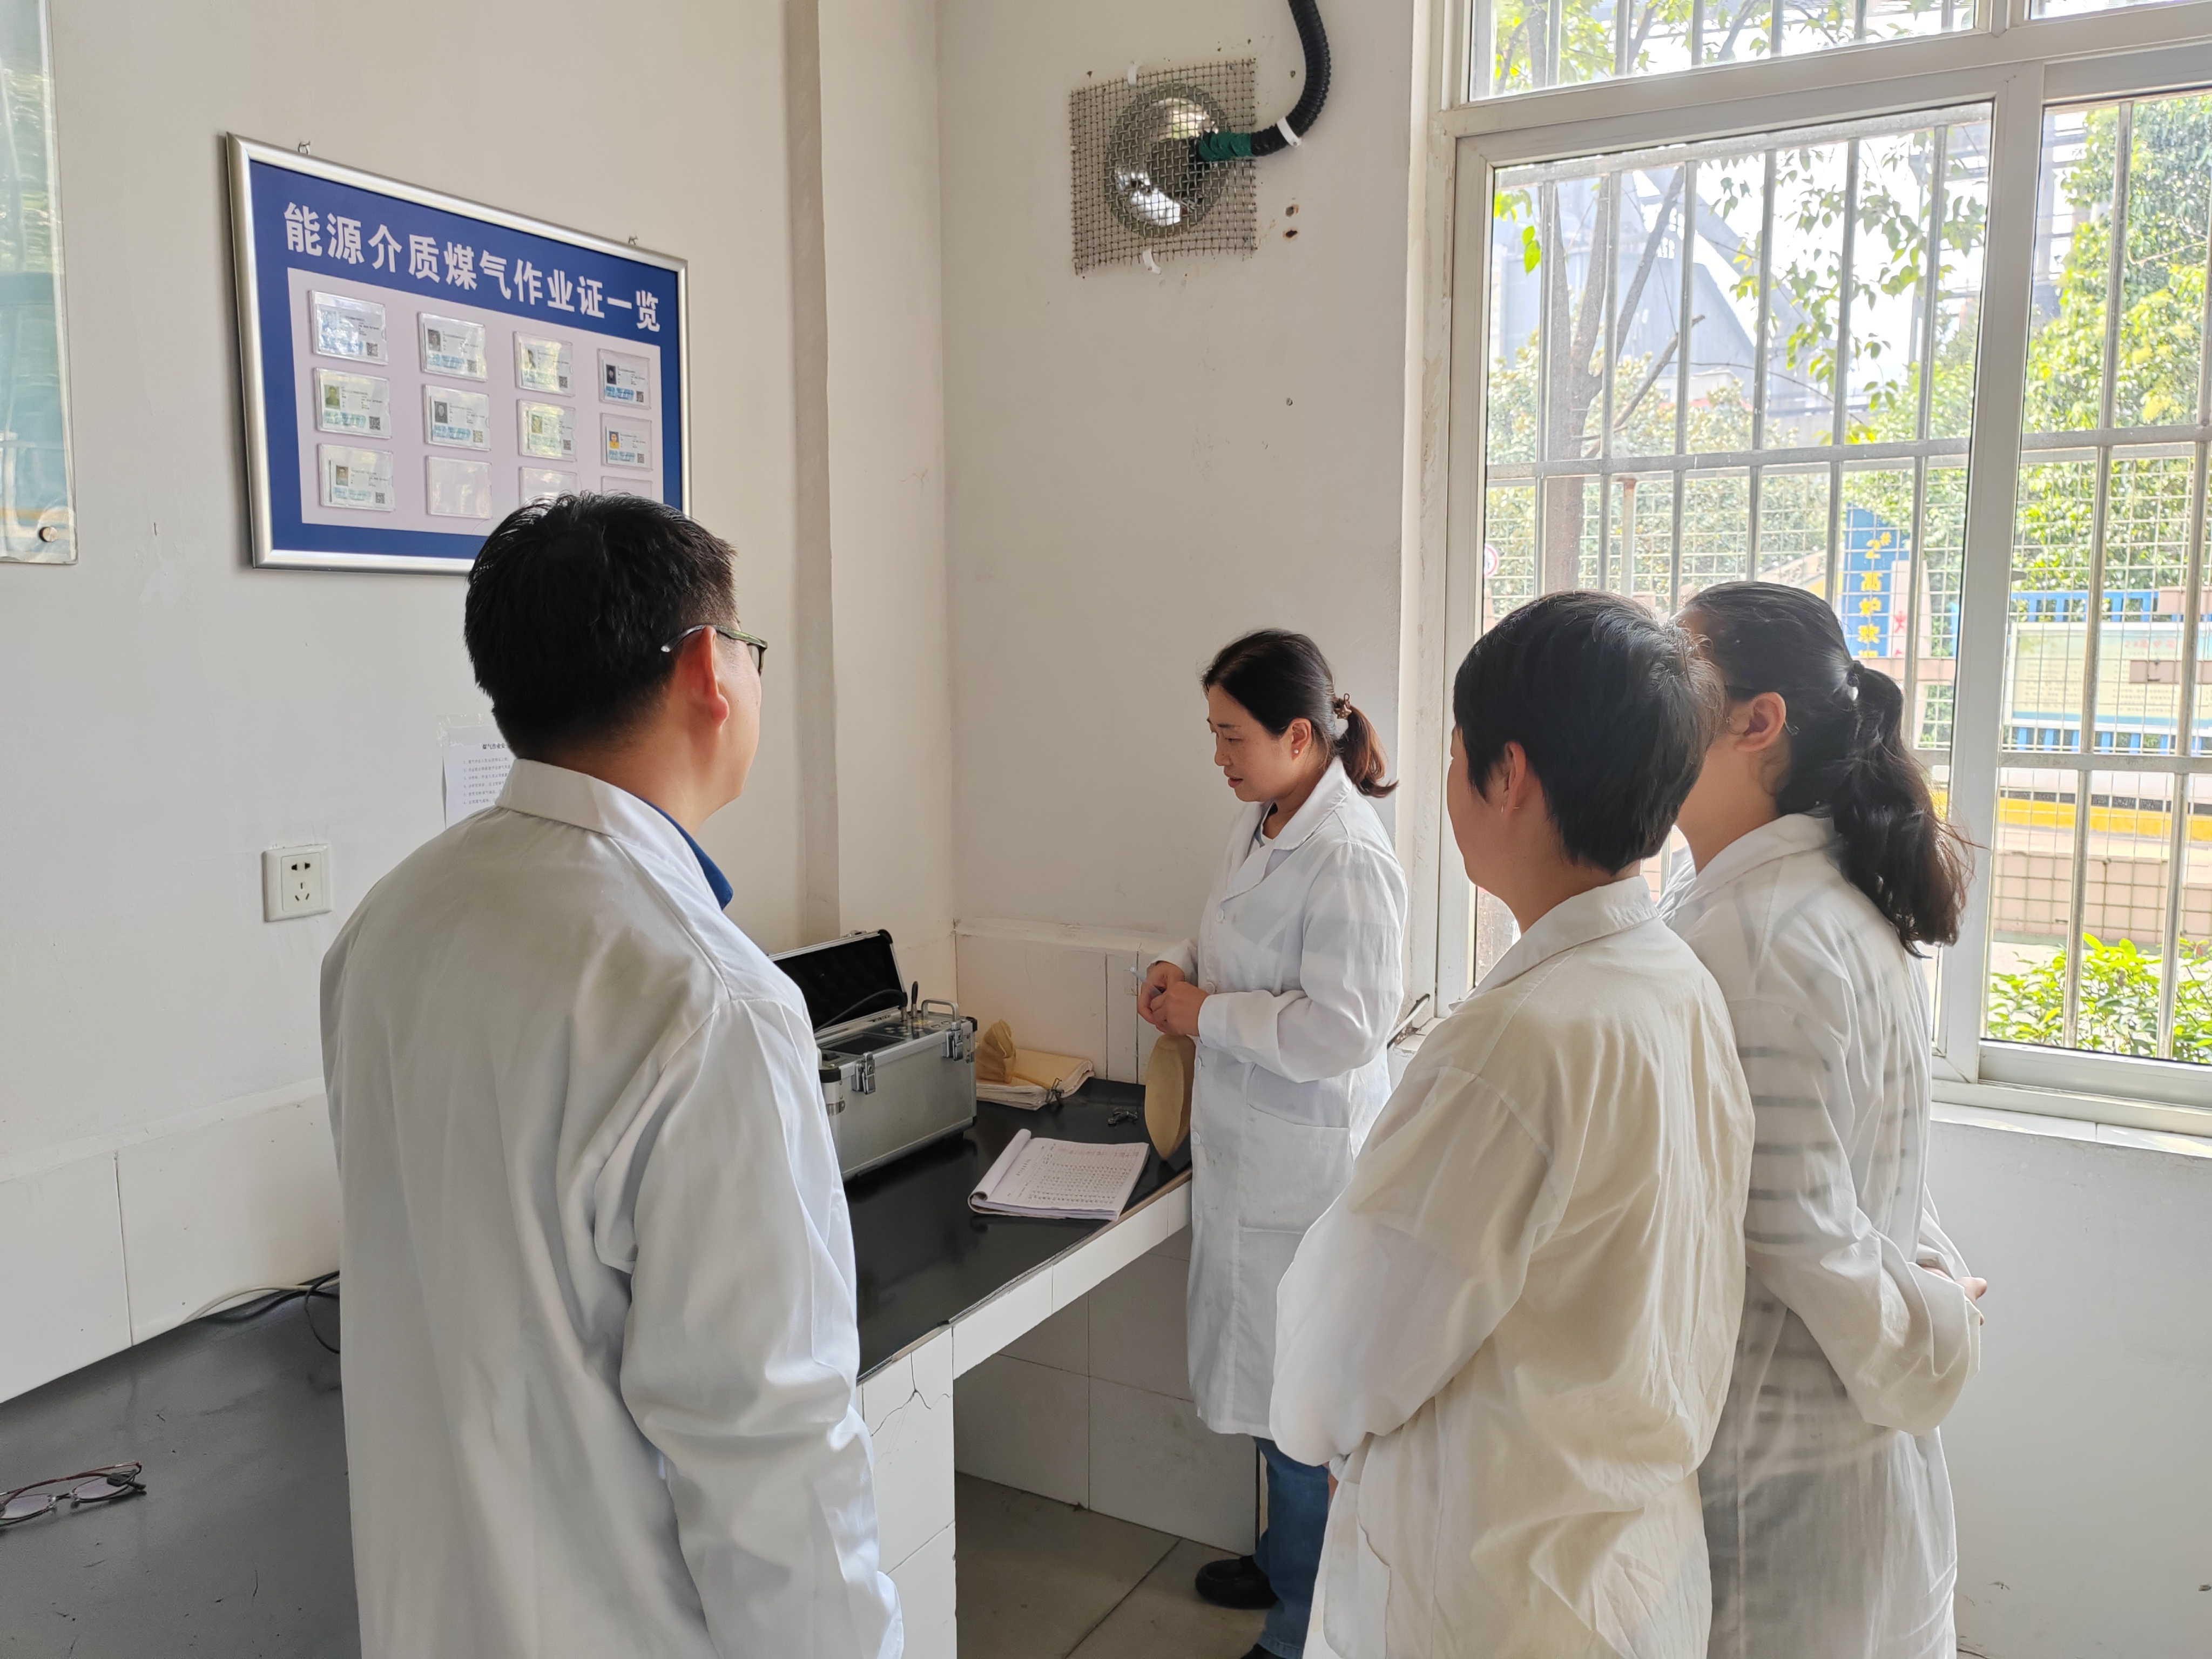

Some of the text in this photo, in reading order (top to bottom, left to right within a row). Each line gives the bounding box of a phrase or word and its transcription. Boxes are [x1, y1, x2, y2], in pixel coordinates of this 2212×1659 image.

[284, 202, 660, 332] 能源介质煤气作业证一览
